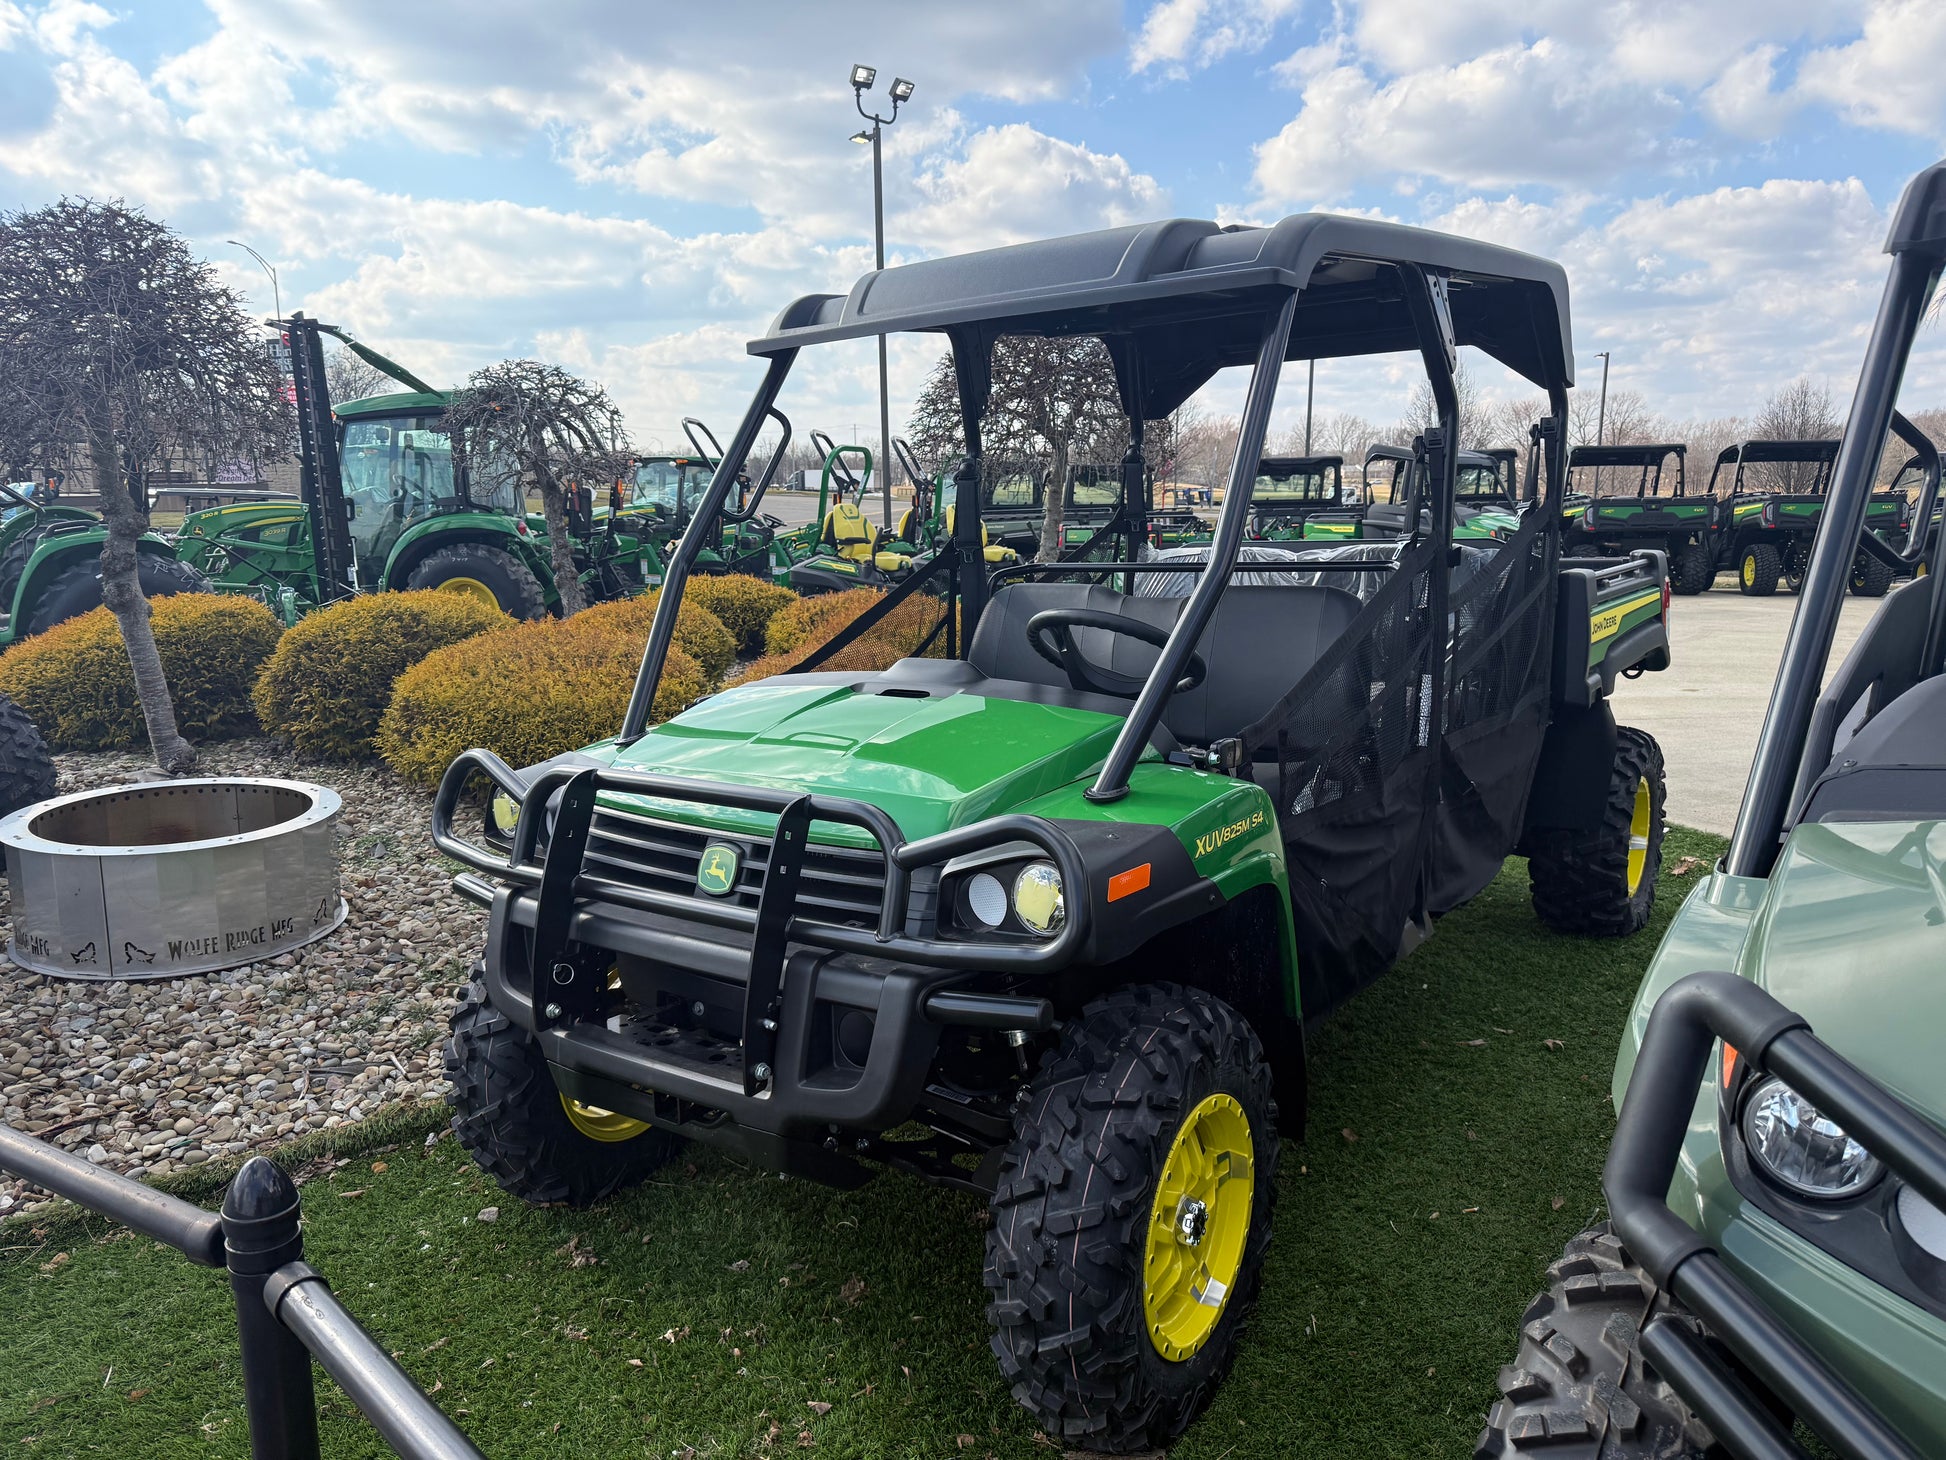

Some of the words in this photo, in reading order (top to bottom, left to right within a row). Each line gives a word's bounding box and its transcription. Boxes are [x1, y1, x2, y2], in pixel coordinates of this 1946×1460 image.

[1592, 623, 1603, 635] JOHN
[1603, 615, 1616, 629] DEERE
[1195, 818, 1249, 858] XUV825M
[1252, 810, 1264, 828] S4
[30, 935, 50, 956] MFG
[168, 937, 219, 961] WOLFE
[225, 926, 266, 952] RIDGE
[271, 917, 293, 941] MFG
